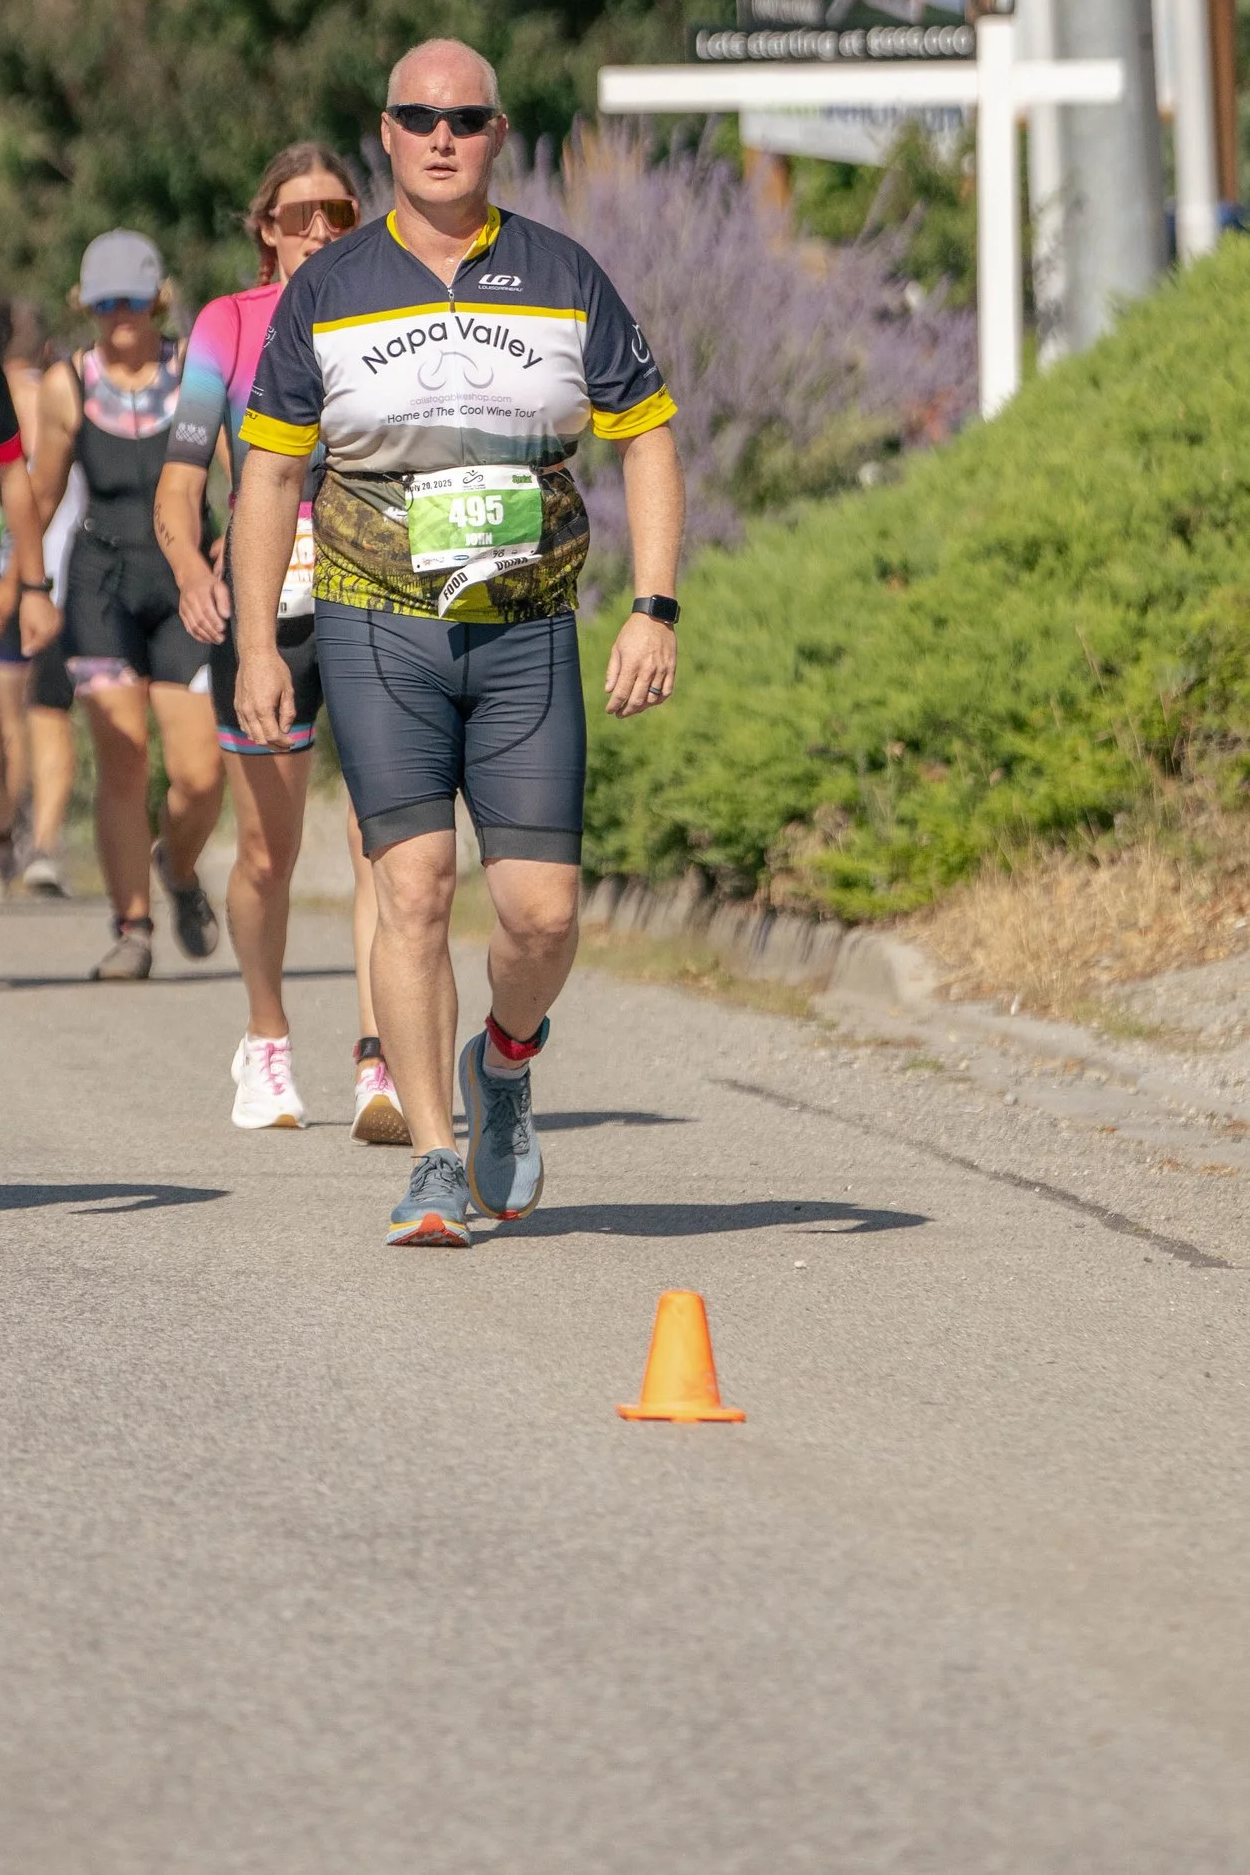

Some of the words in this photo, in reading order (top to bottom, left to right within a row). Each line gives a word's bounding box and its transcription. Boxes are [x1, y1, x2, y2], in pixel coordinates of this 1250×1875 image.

[361, 321, 449, 375] Napa
[454, 315, 543, 370] Valley
[387, 411, 420, 424] Home
[423, 407, 434, 419] of
[436, 406, 455, 417] The
[459, 405, 484, 416] Cool
[486, 406, 512, 418] Wine
[514, 408, 537, 418] Tour
[433, 478, 453, 489] 2025
[449, 494, 504, 529] 495
[464, 532, 493, 546] JOHN
[443, 571, 469, 601] FOOD
